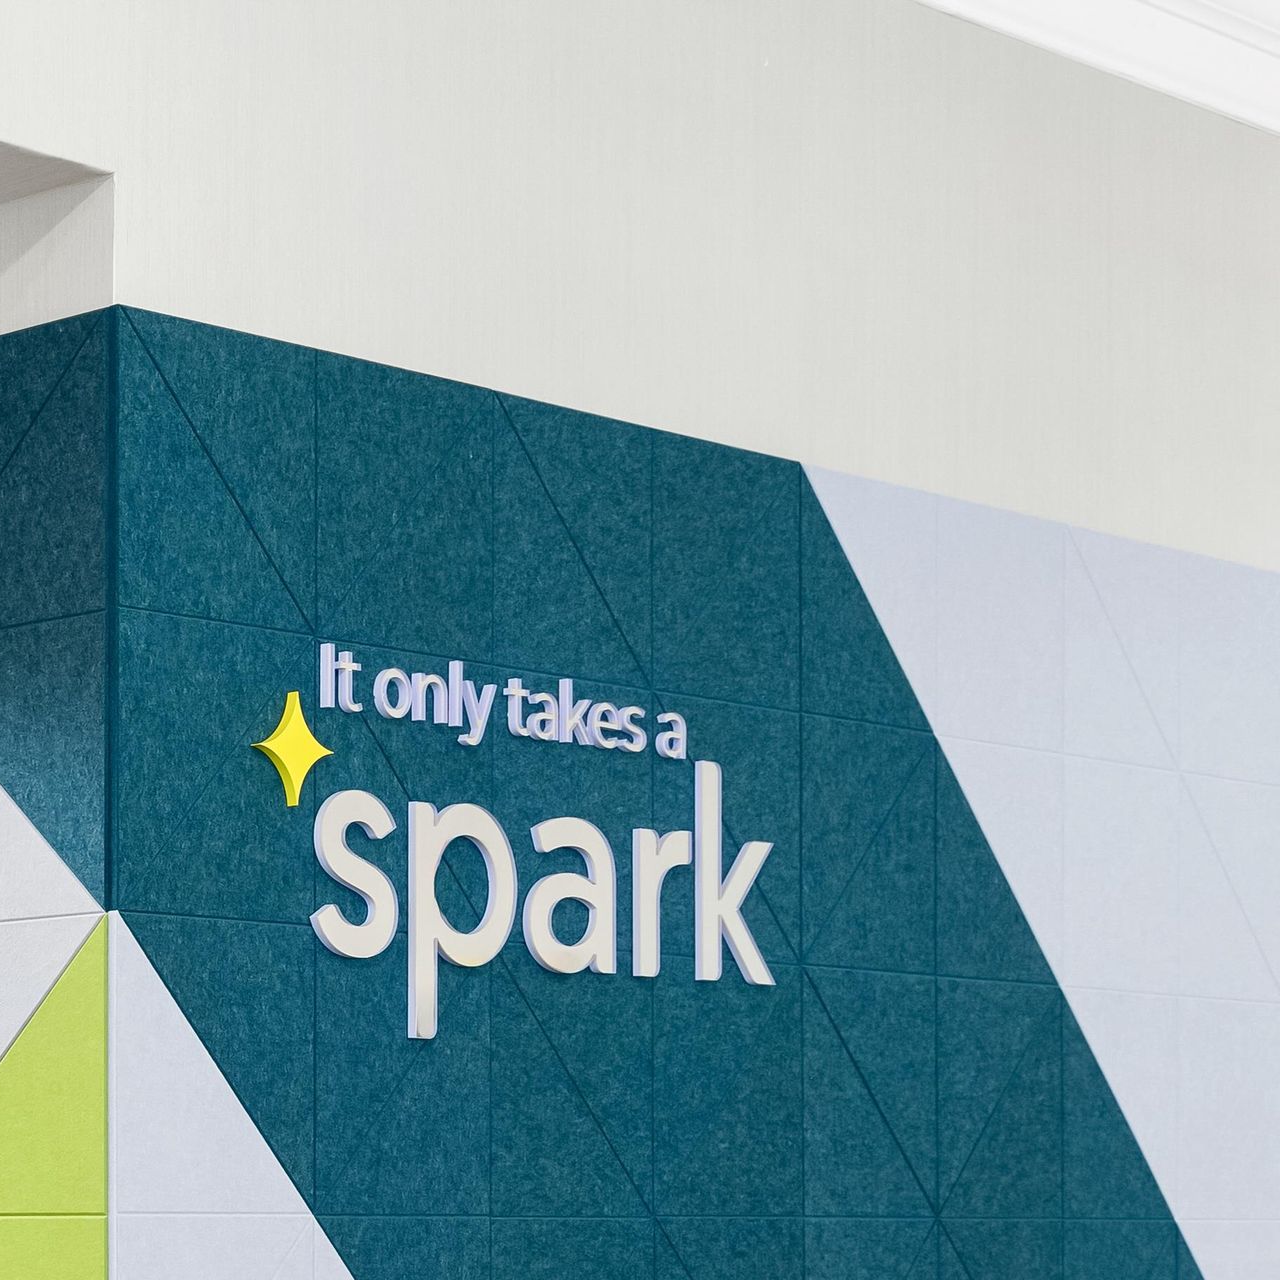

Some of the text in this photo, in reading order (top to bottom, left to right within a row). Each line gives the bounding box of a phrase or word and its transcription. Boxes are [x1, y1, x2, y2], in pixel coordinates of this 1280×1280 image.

[319, 642, 688, 760] It only takes a
[309, 760, 777, 1041] spark
